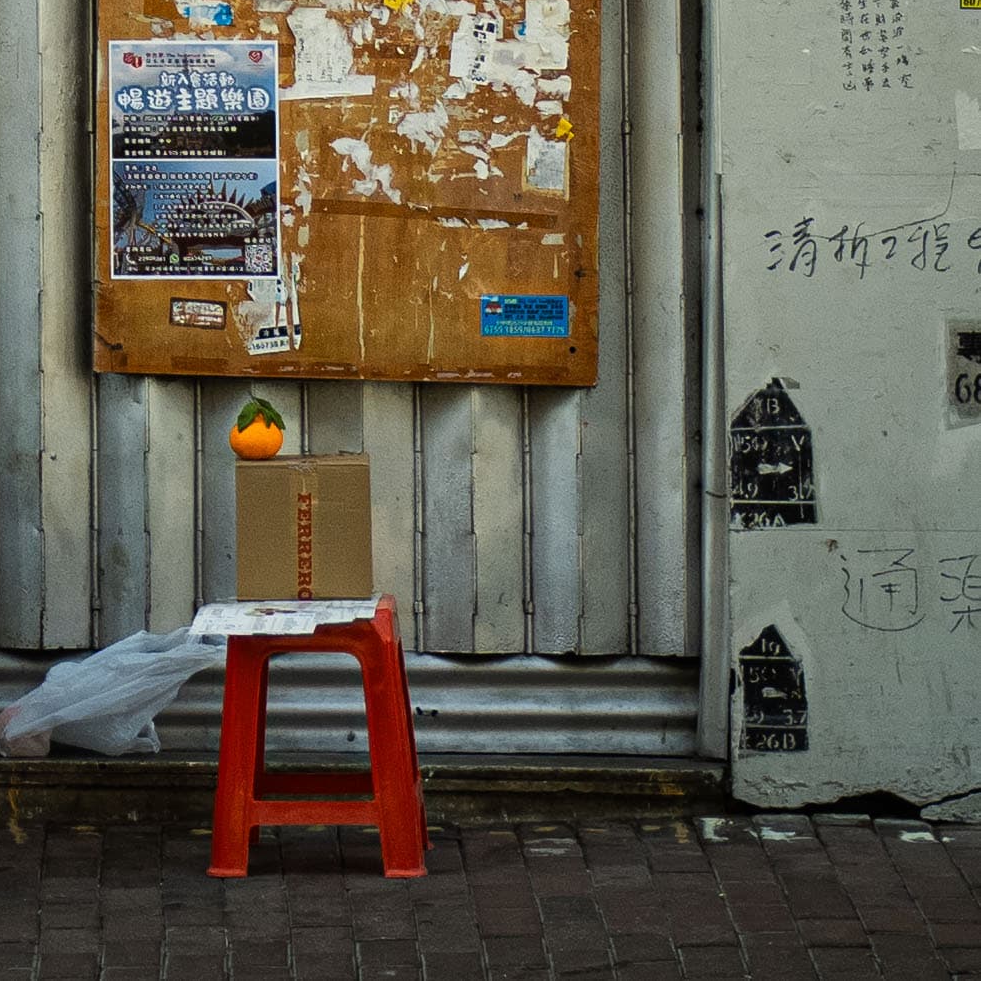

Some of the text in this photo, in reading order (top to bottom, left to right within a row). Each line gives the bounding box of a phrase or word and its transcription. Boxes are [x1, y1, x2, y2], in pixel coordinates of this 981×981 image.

[160, 72, 236, 87] 新入會活動
[117, 87, 270, 111] 暢遊主題樂園
[297, 492, 313, 601] FERRERO
